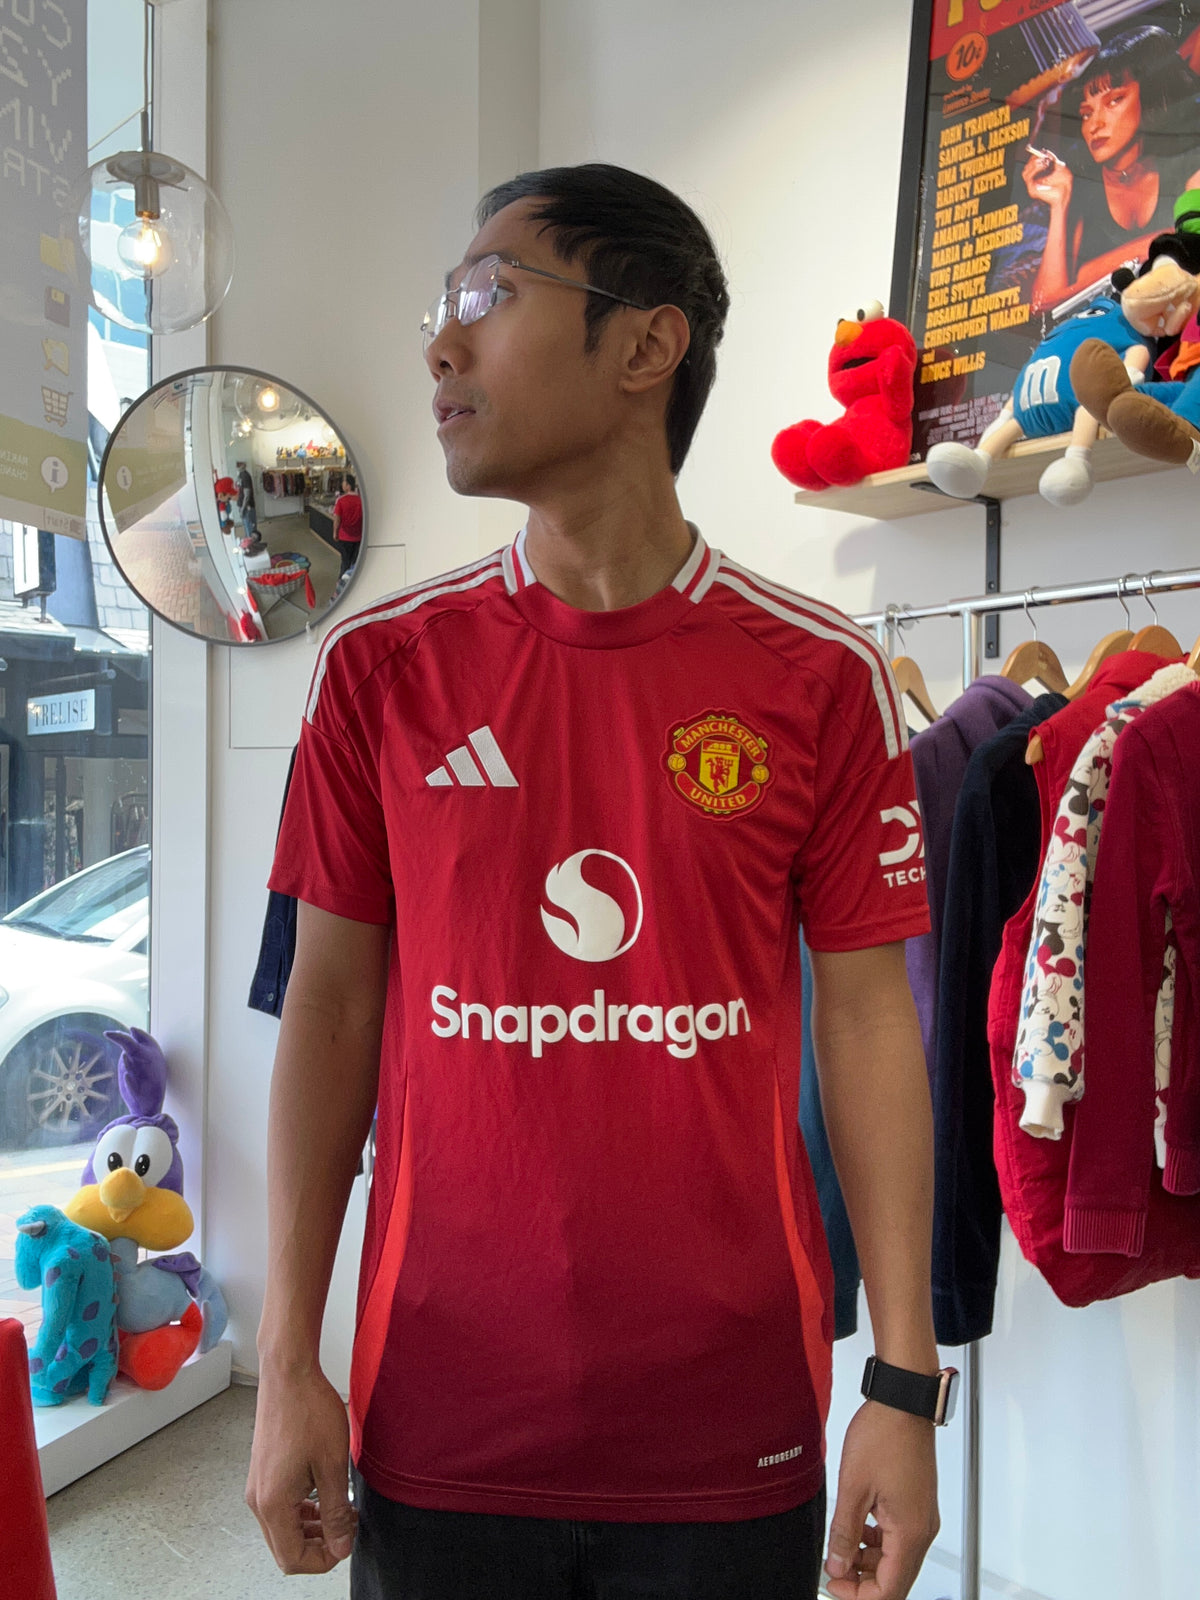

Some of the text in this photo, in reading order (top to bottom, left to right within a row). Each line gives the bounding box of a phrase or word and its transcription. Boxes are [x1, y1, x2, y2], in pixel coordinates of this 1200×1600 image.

[988, 118, 1030, 151] JACKSON
[972, 204, 1019, 237] PLUMMER
[924, 315, 988, 350] CHRISTOPHER
[953, 351, 986, 377] WILLIS
[1020, 355, 1061, 412] m
[33, 698, 88, 727] TRELISE
[681, 722, 761, 757] MANCHESTER
[690, 788, 746, 808] UNITED
[431, 984, 751, 1059] Snapdragon
[757, 1445, 803, 1468] AEROREADY
